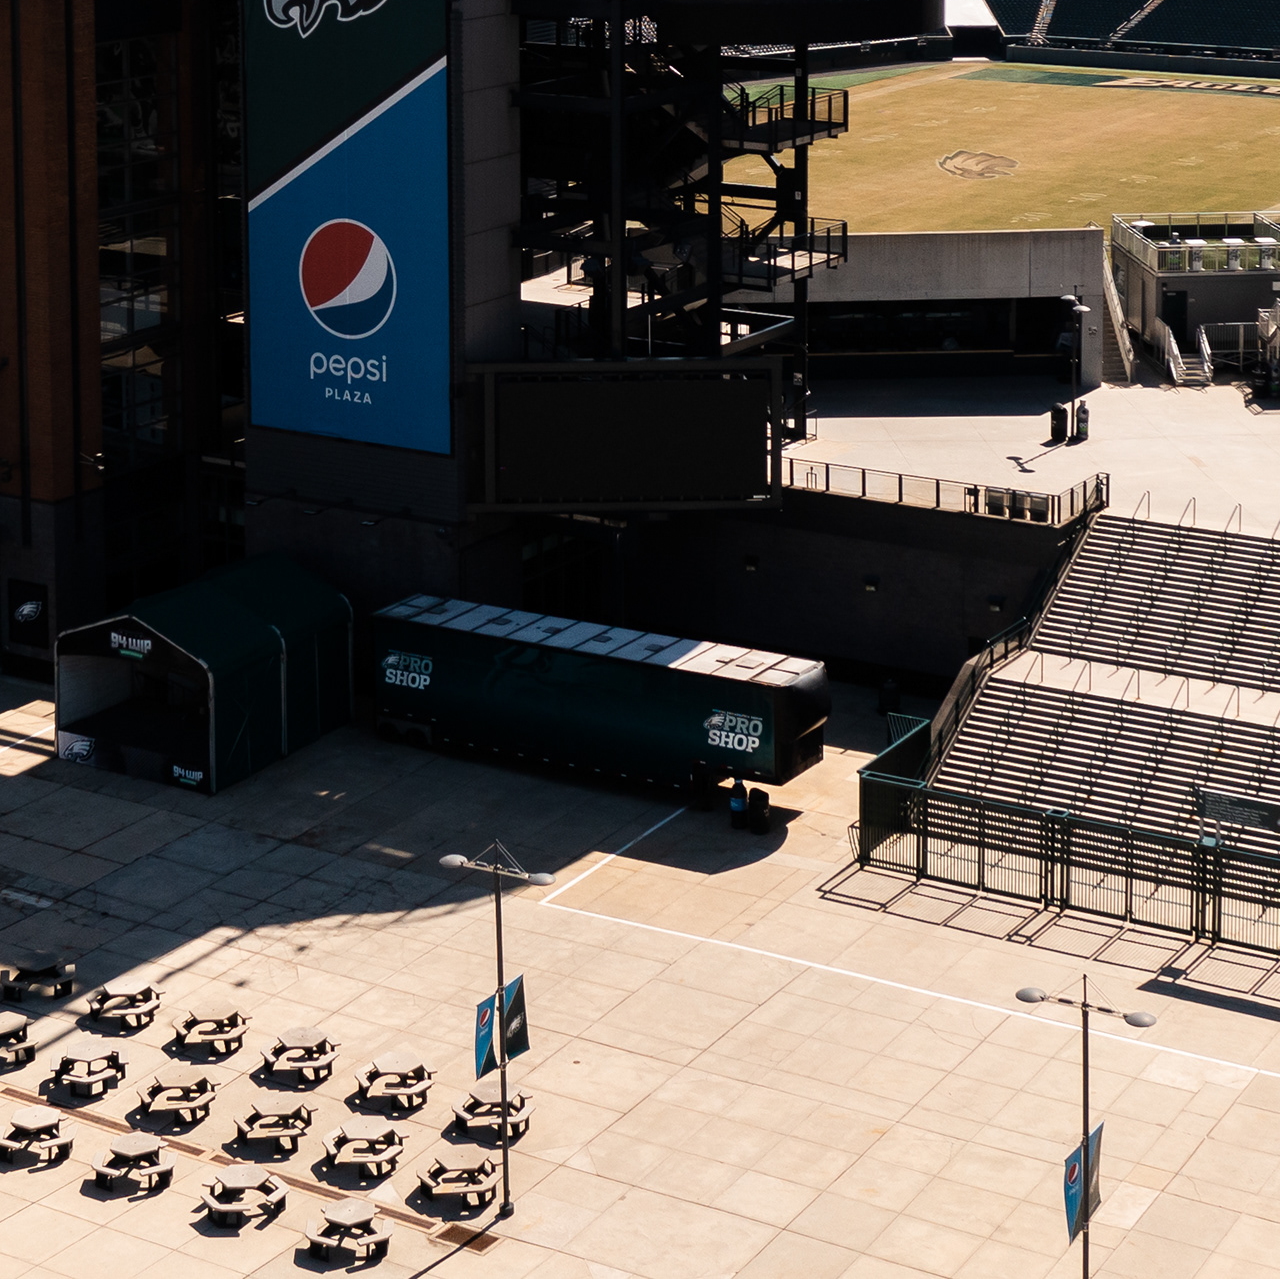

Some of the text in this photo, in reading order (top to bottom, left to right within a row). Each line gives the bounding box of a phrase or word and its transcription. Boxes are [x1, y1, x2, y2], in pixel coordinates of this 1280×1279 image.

[309, 352, 387, 385] pepsi
[325, 387, 372, 405] PLAZA
[110, 631, 127, 649] 94
[128, 636, 152, 654] WIP
[399, 655, 434, 675] PRO
[385, 668, 431, 690] SHOP
[723, 714, 764, 737] PRO
[707, 729, 760, 753] SHOP
[172, 764, 203, 781] 94 WIP
